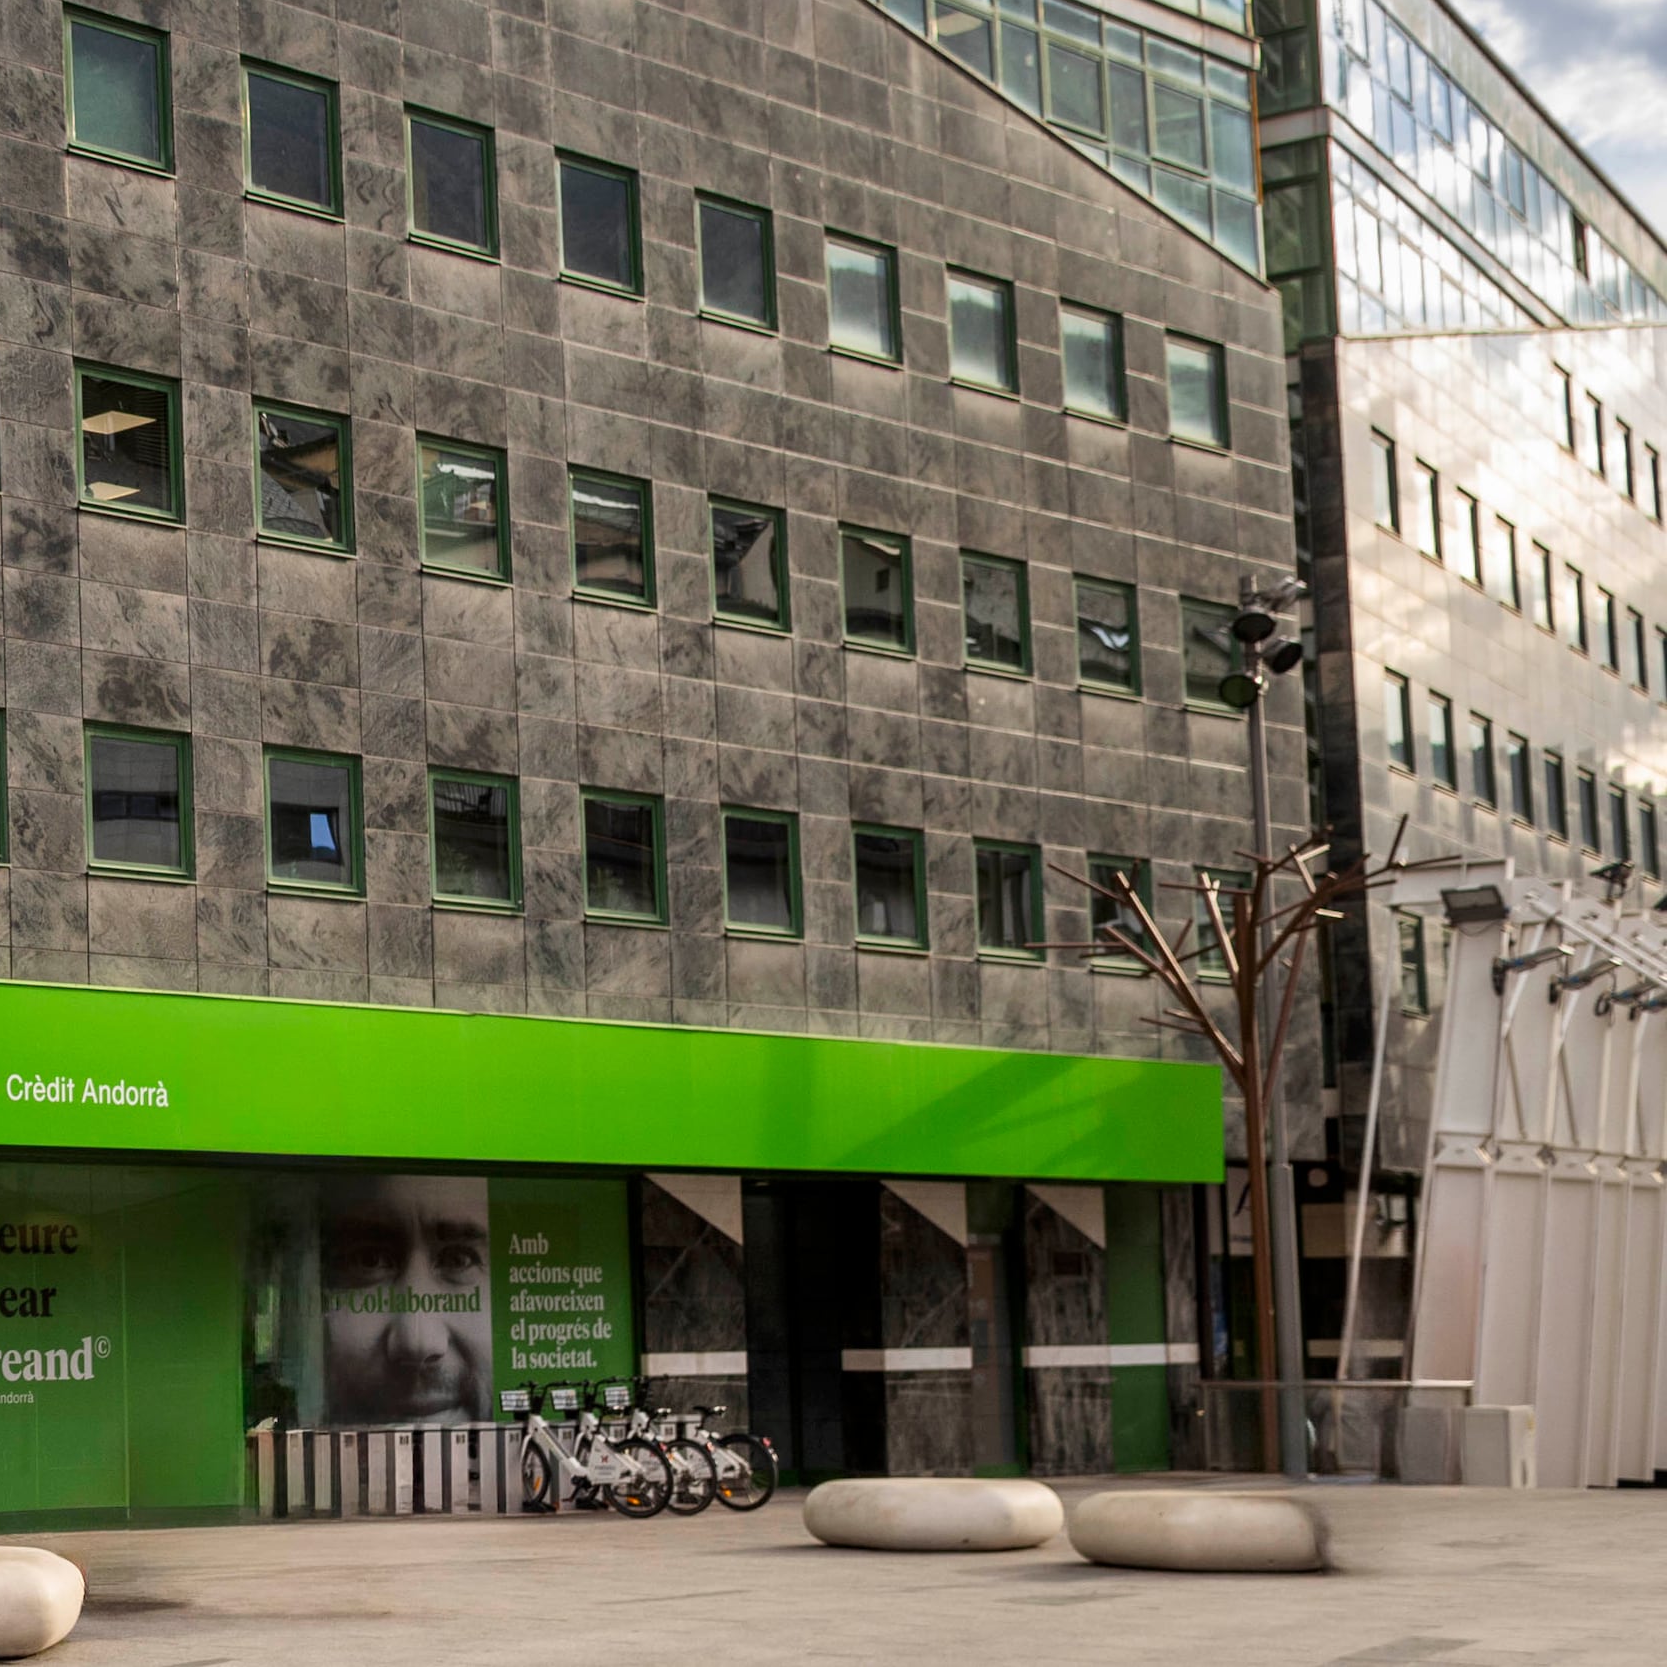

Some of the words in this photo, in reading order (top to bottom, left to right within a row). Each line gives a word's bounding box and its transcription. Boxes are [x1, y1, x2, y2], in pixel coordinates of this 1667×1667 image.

[6, 1074, 76, 1103] Crèdit
[81, 1077, 169, 1108] Andorrà
[509, 1233, 549, 1255] Amb
[509, 1261, 571, 1283] accions
[573, 1266, 603, 1289] que
[510, 1289, 605, 1312] afavoreixen
[510, 1318, 526, 1341] el
[592, 1317, 612, 1339] de
[511, 1346, 527, 1369] la
[529, 1346, 598, 1369] societat.
